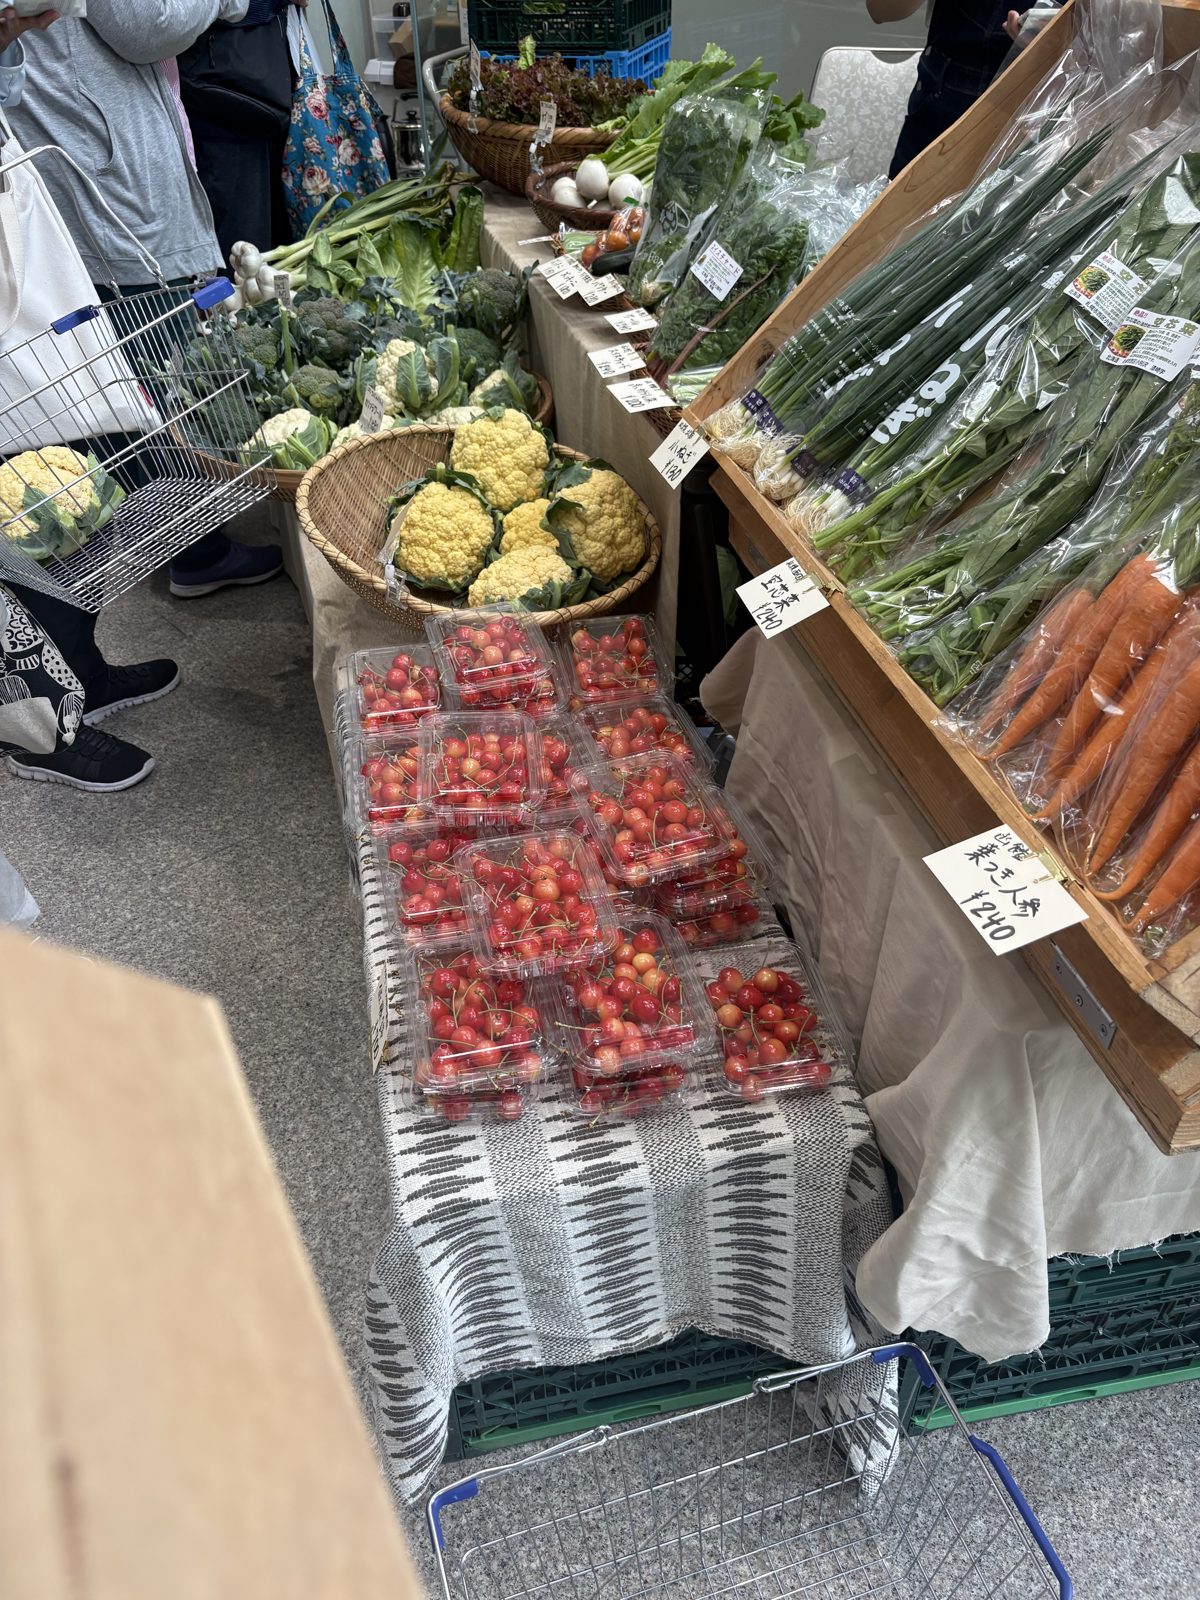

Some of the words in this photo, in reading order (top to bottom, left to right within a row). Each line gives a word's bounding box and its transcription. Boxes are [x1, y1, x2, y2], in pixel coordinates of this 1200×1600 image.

[710, 244, 742, 275] スイスチャード
[1118, 268, 1148, 296] 空芯
[667, 439, 697, 465] 小ねぎ
[660, 457, 682, 482] ¥130
[761, 574, 800, 614] 空芯菜
[752, 602, 783, 630] ¥240
[964, 842, 1041, 918] 葉つき人参
[960, 890, 1016, 941] ¥240
